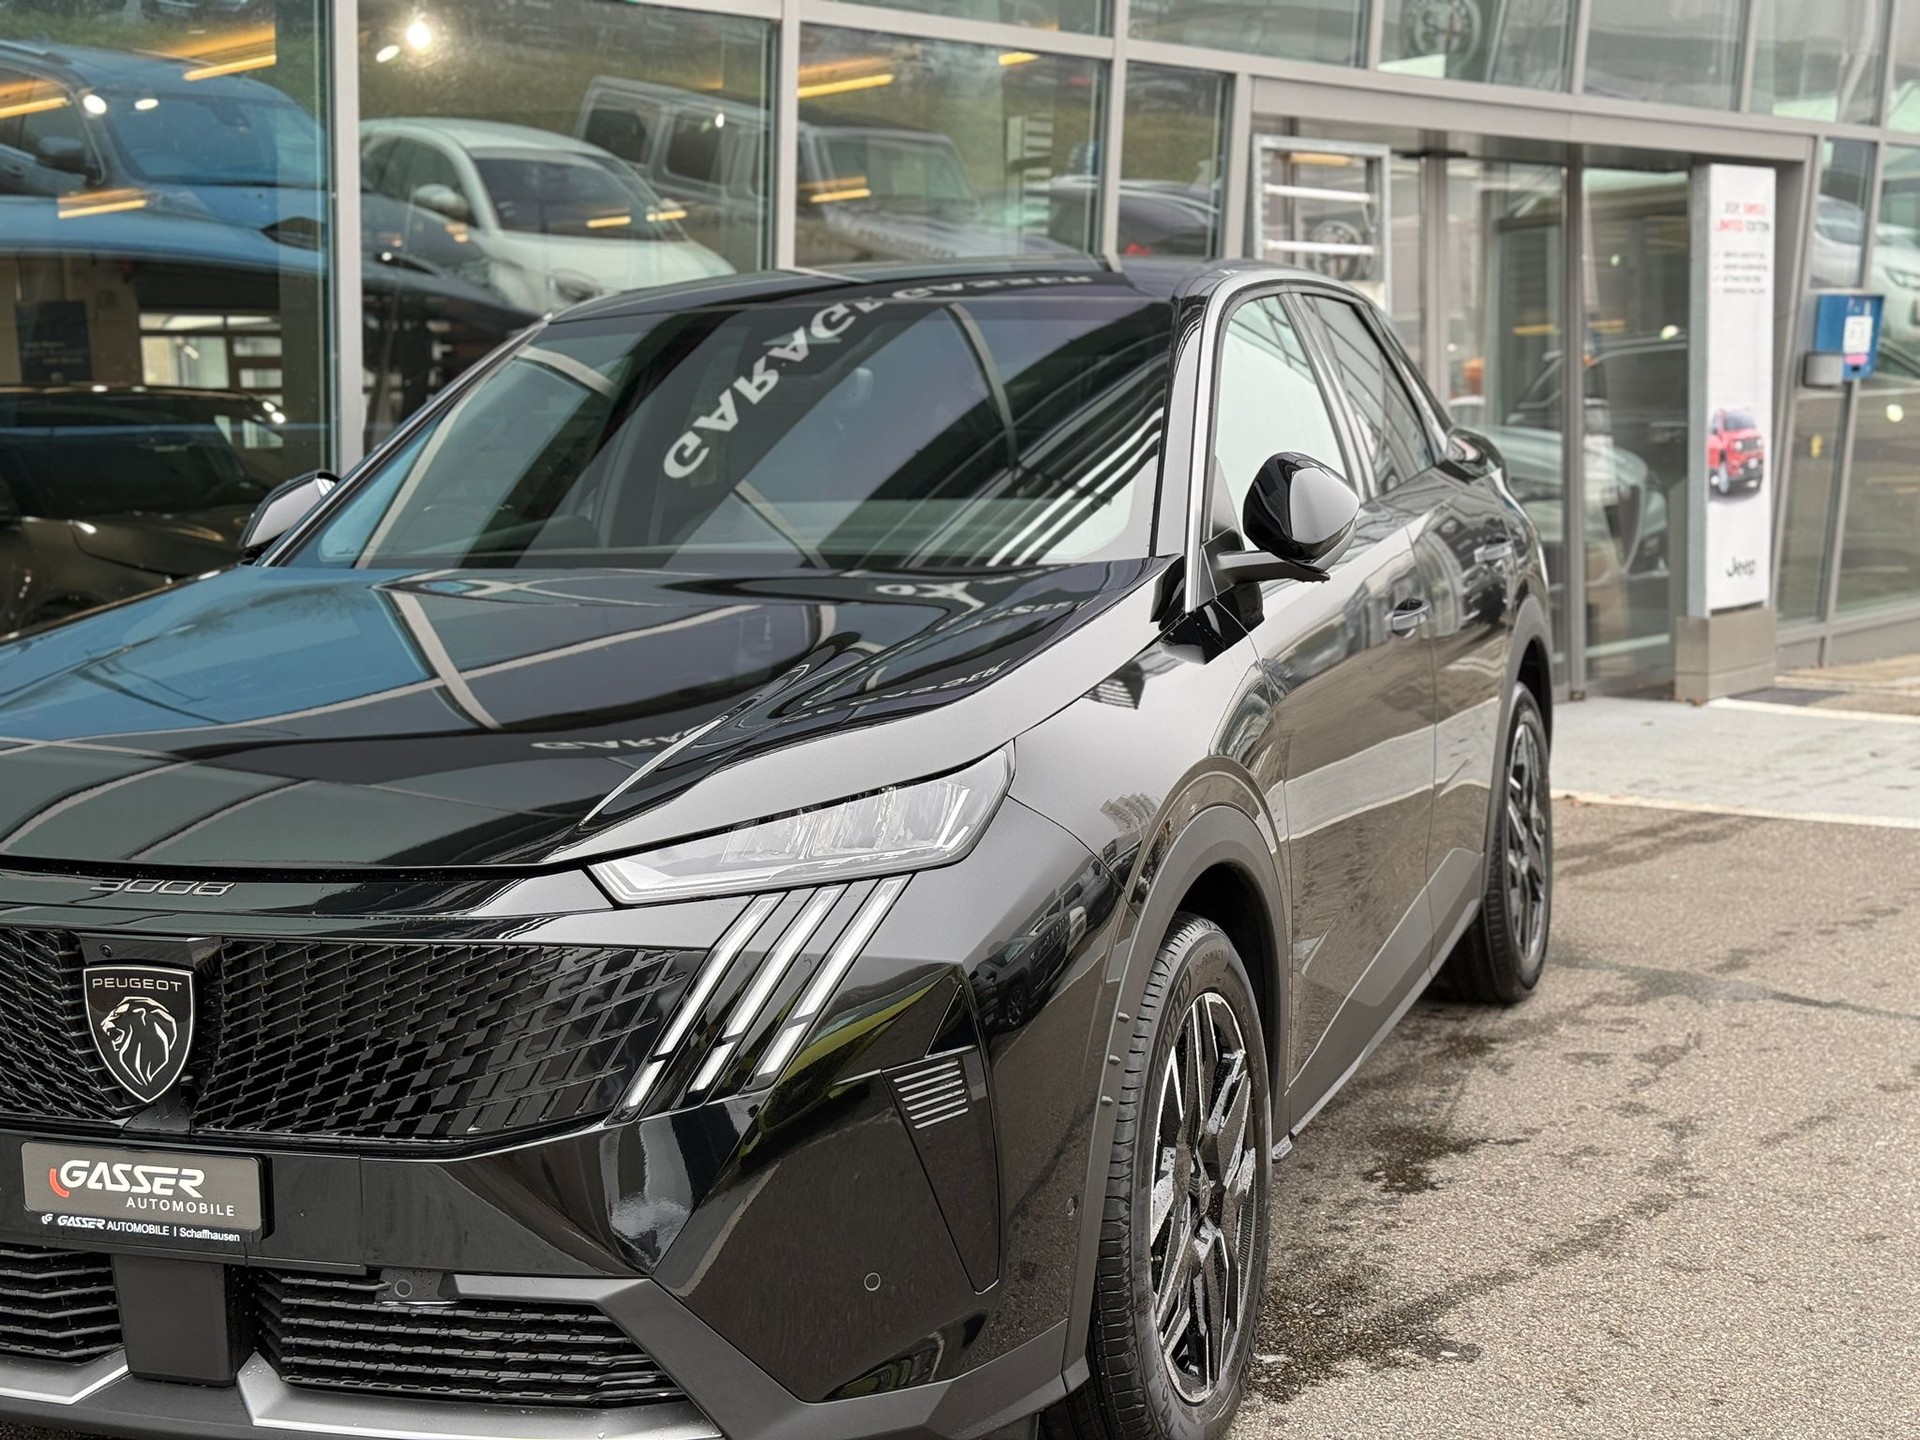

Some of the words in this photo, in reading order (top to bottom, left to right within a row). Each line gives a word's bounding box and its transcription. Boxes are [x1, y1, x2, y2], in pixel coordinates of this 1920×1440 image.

[90, 878, 235, 896] 3008
[92, 977, 182, 992] PEUGEOT
[60, 1159, 205, 1198] GASSER
[126, 1197, 235, 1217] AUTOMOBILE
[57, 1214, 106, 1230] GASSER
[106, 1222, 169, 1237] AUTOMOBILE
[179, 1227, 240, 1242] Schaffhausen
